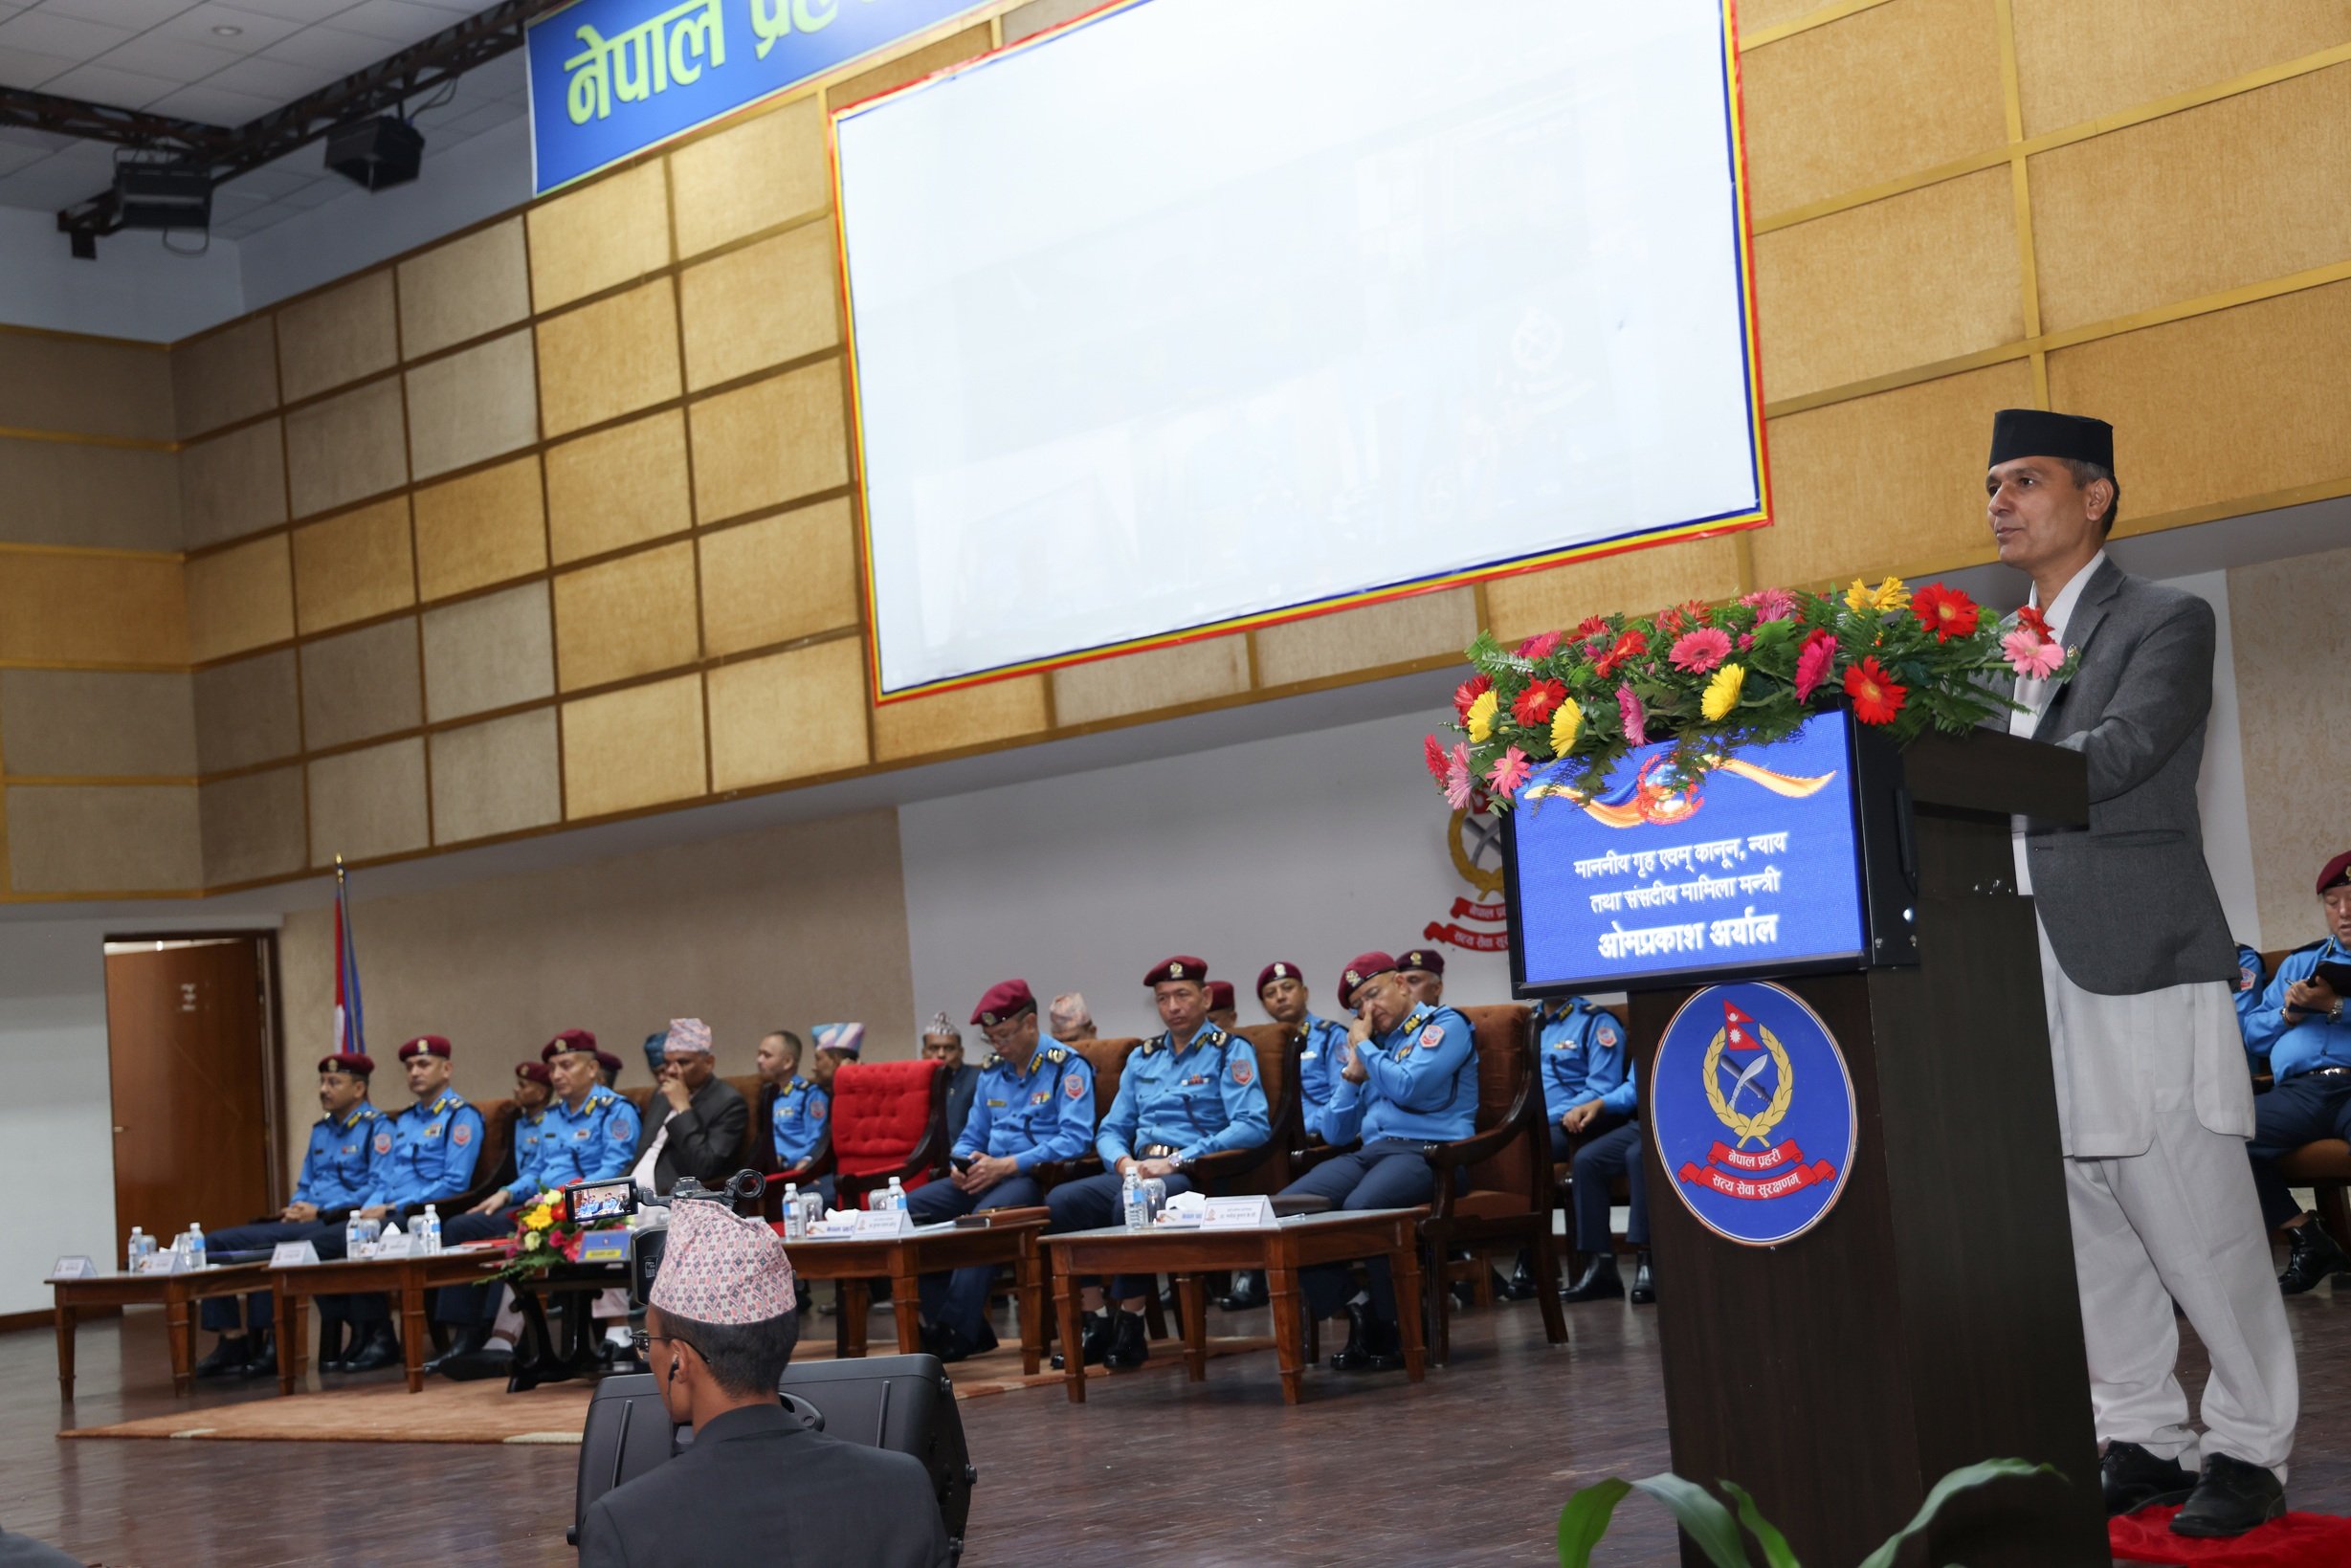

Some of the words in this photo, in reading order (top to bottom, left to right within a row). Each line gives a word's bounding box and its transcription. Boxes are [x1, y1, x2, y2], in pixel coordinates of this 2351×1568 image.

[564, 0, 726, 124] नेपाल
[1574, 850, 1630, 878] माननीय
[1632, 850, 1656, 877] गृह
[1657, 846, 1695, 872] एवम्
[1694, 838, 1746, 869] कानून,
[1747, 831, 1787, 854] न्याय
[1589, 892, 1622, 913] तथा
[1623, 879, 1678, 909] संसदीय
[1679, 873, 1737, 901] मामिला
[1738, 865, 1782, 894] मन्त्री
[1598, 920, 1705, 958] ओमप्रकाश
[1710, 906, 1779, 947] अर्याल
[1728, 1149, 1755, 1167] नेपाल
[1758, 1148, 1781, 1168] प्रहरी
[1713, 1173, 1735, 1192] सत्य
[1737, 1181, 1755, 1196] सेवा
